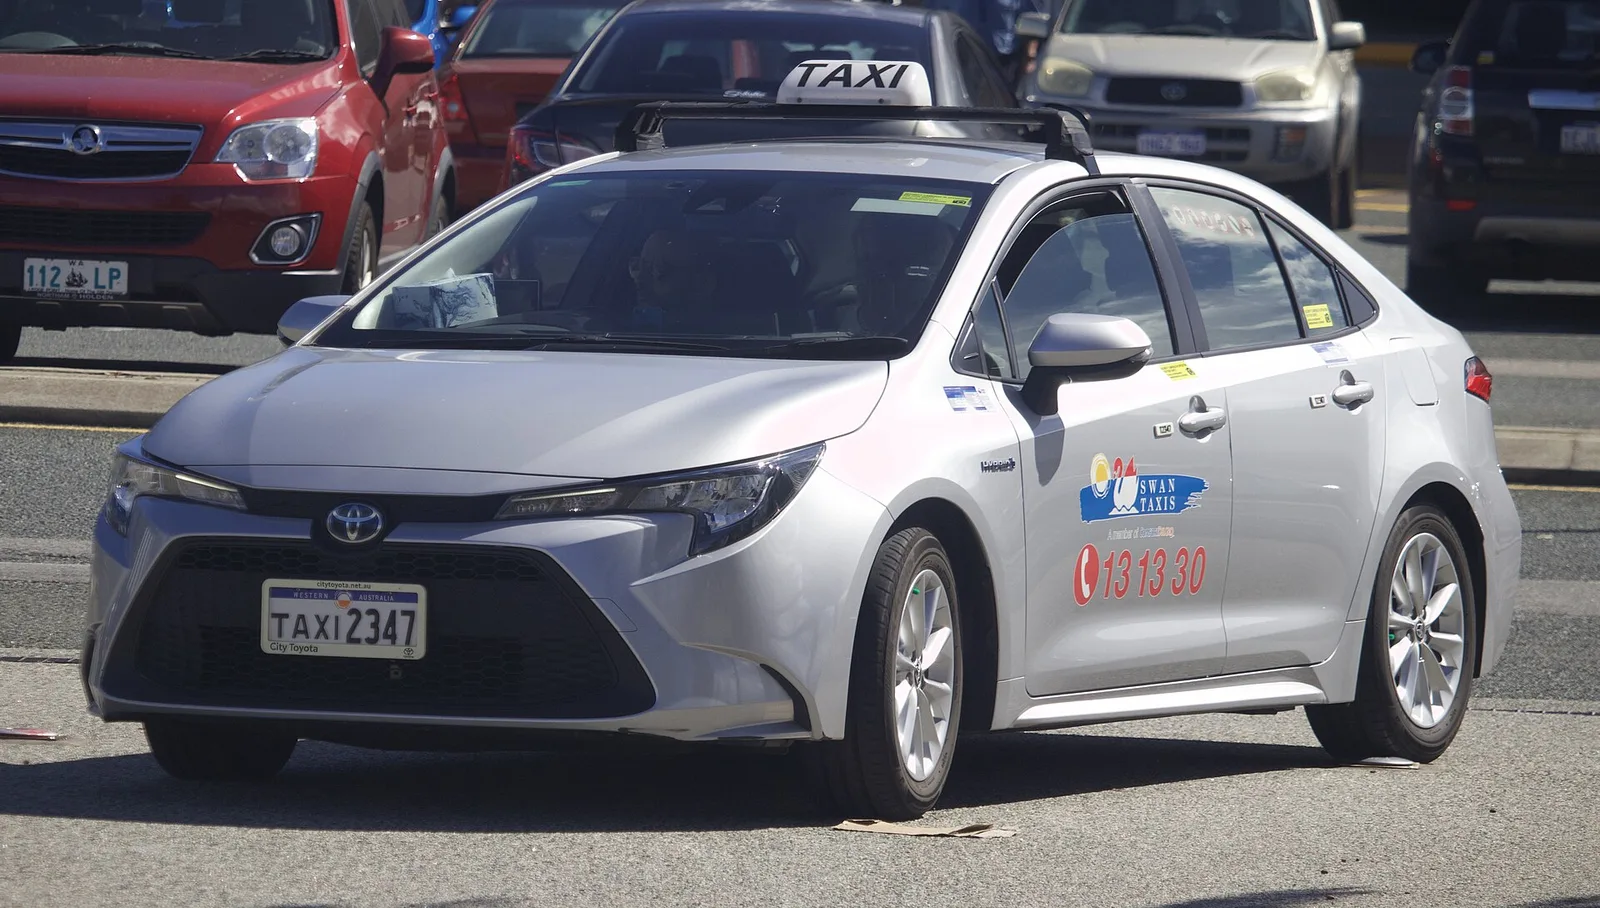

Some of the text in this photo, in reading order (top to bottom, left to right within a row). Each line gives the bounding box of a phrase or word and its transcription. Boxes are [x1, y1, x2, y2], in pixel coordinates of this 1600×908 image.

[797, 63, 909, 88] TAXI
[27, 265, 121, 290] 112 LP
[1140, 478, 1176, 494] SWAN
[1140, 495, 1176, 512] TAXIS
[1103, 545, 1207, 599] 13 13 30
[316, 581, 372, 590] citytoyota.net.au
[270, 642, 319, 654] City Toyota
